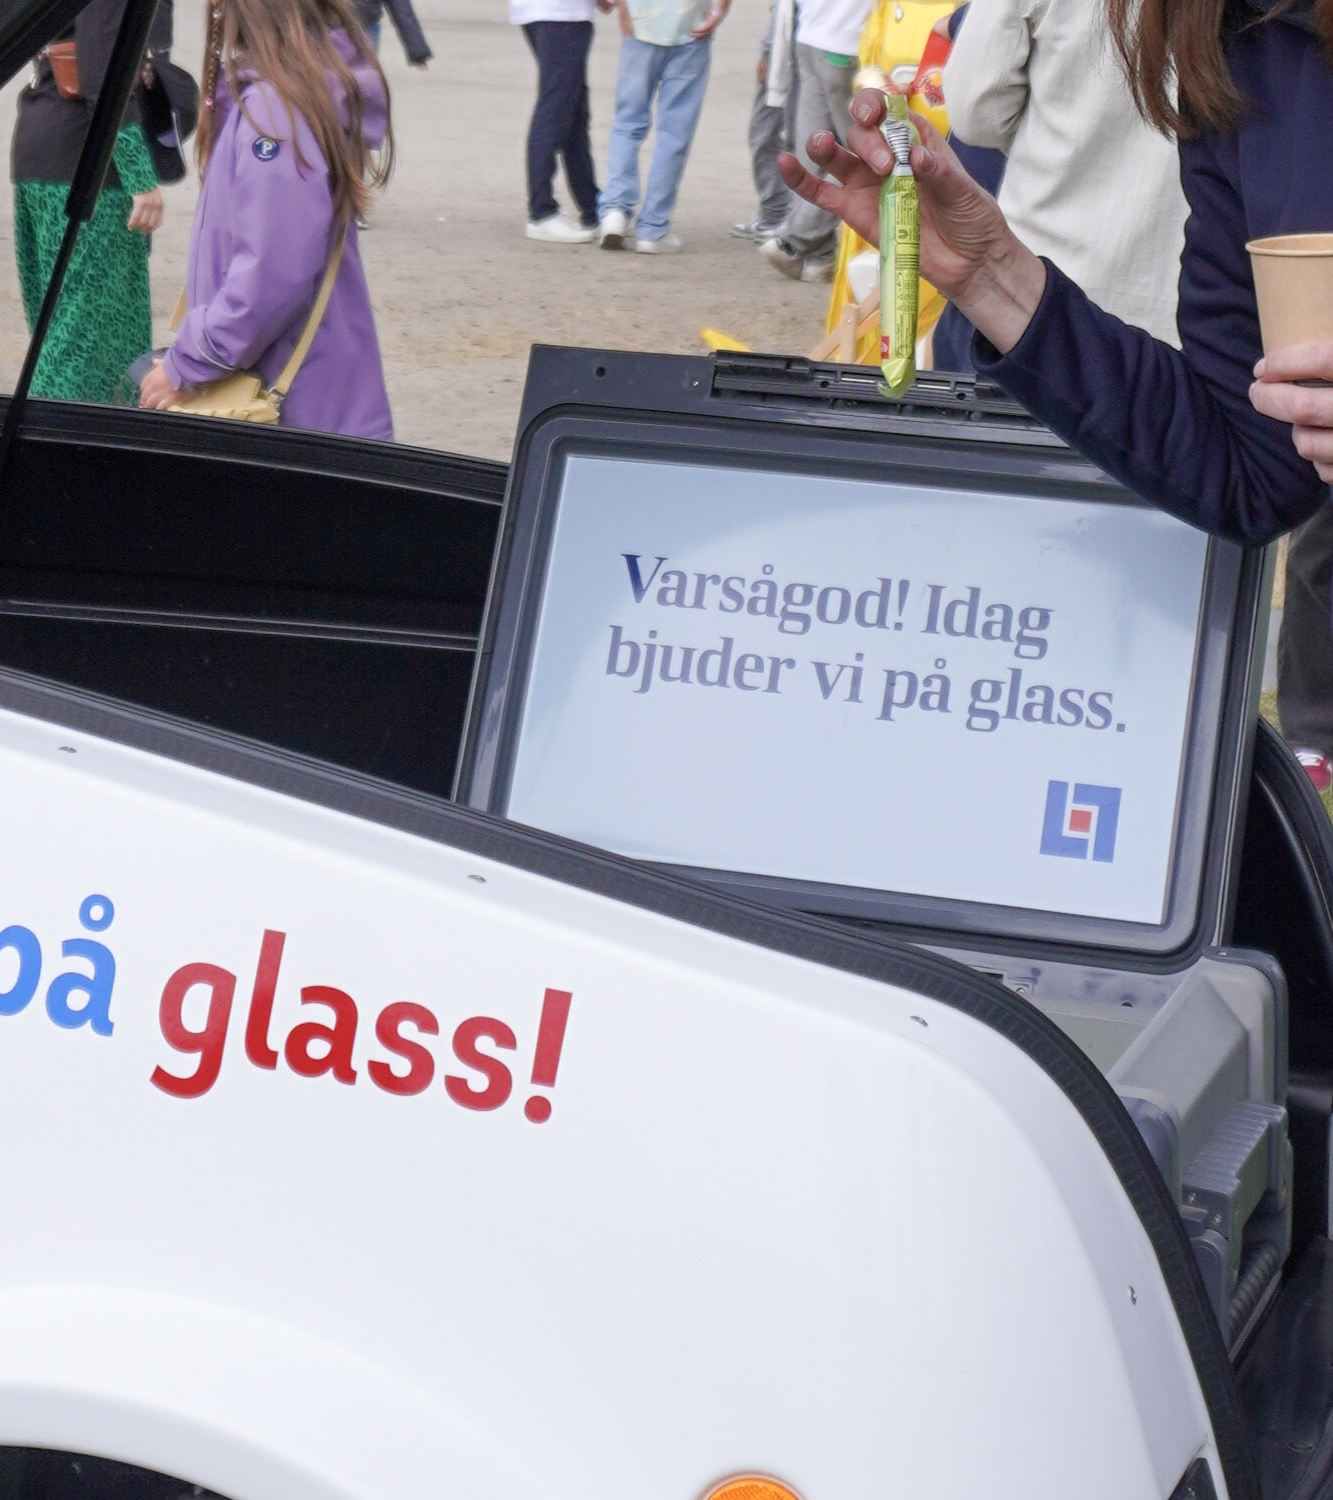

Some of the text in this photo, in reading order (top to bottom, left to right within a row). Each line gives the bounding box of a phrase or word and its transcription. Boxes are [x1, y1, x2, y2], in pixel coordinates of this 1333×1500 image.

[620, 552, 1054, 659] Varsågod! Idag
[605, 624, 1128, 733] bjuder vi på glass.
[149, 928, 573, 1124] glass!
